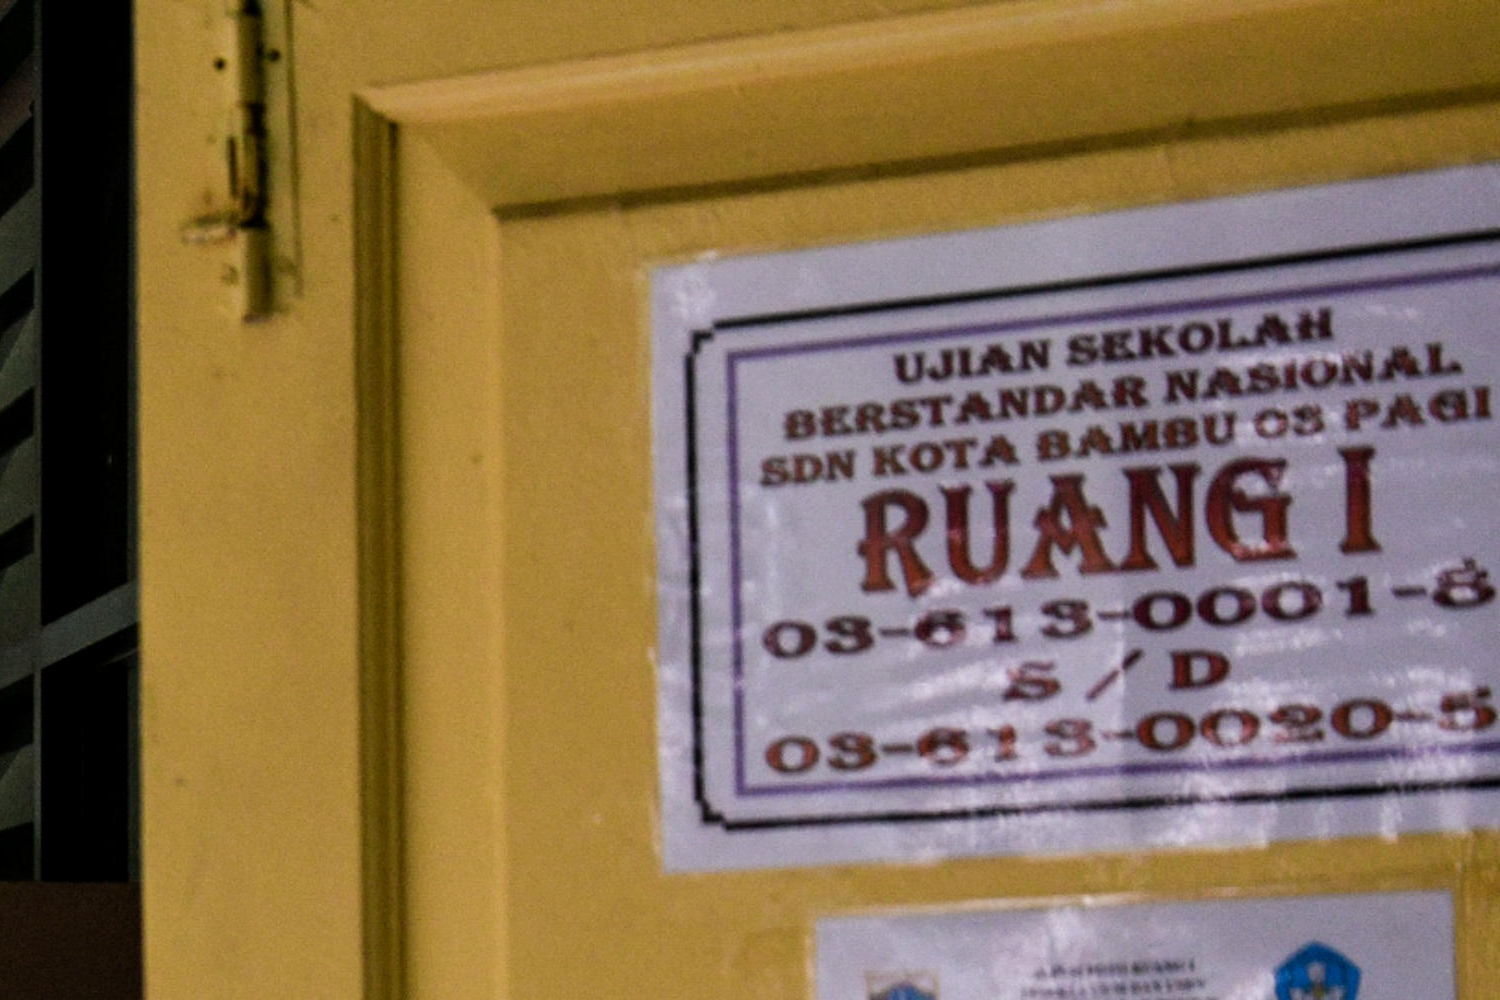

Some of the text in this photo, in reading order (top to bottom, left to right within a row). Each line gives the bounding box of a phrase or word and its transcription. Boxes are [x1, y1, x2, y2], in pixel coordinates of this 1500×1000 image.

[783, 341, 1464, 441] BERSTANDAR NASIONAL
[894, 305, 1334, 384] UJIAN SEKOLAH
[759, 385, 1492, 487] SDN KOTA BAMBU 03 PAGI
[857, 445, 1382, 598] RUANG I
